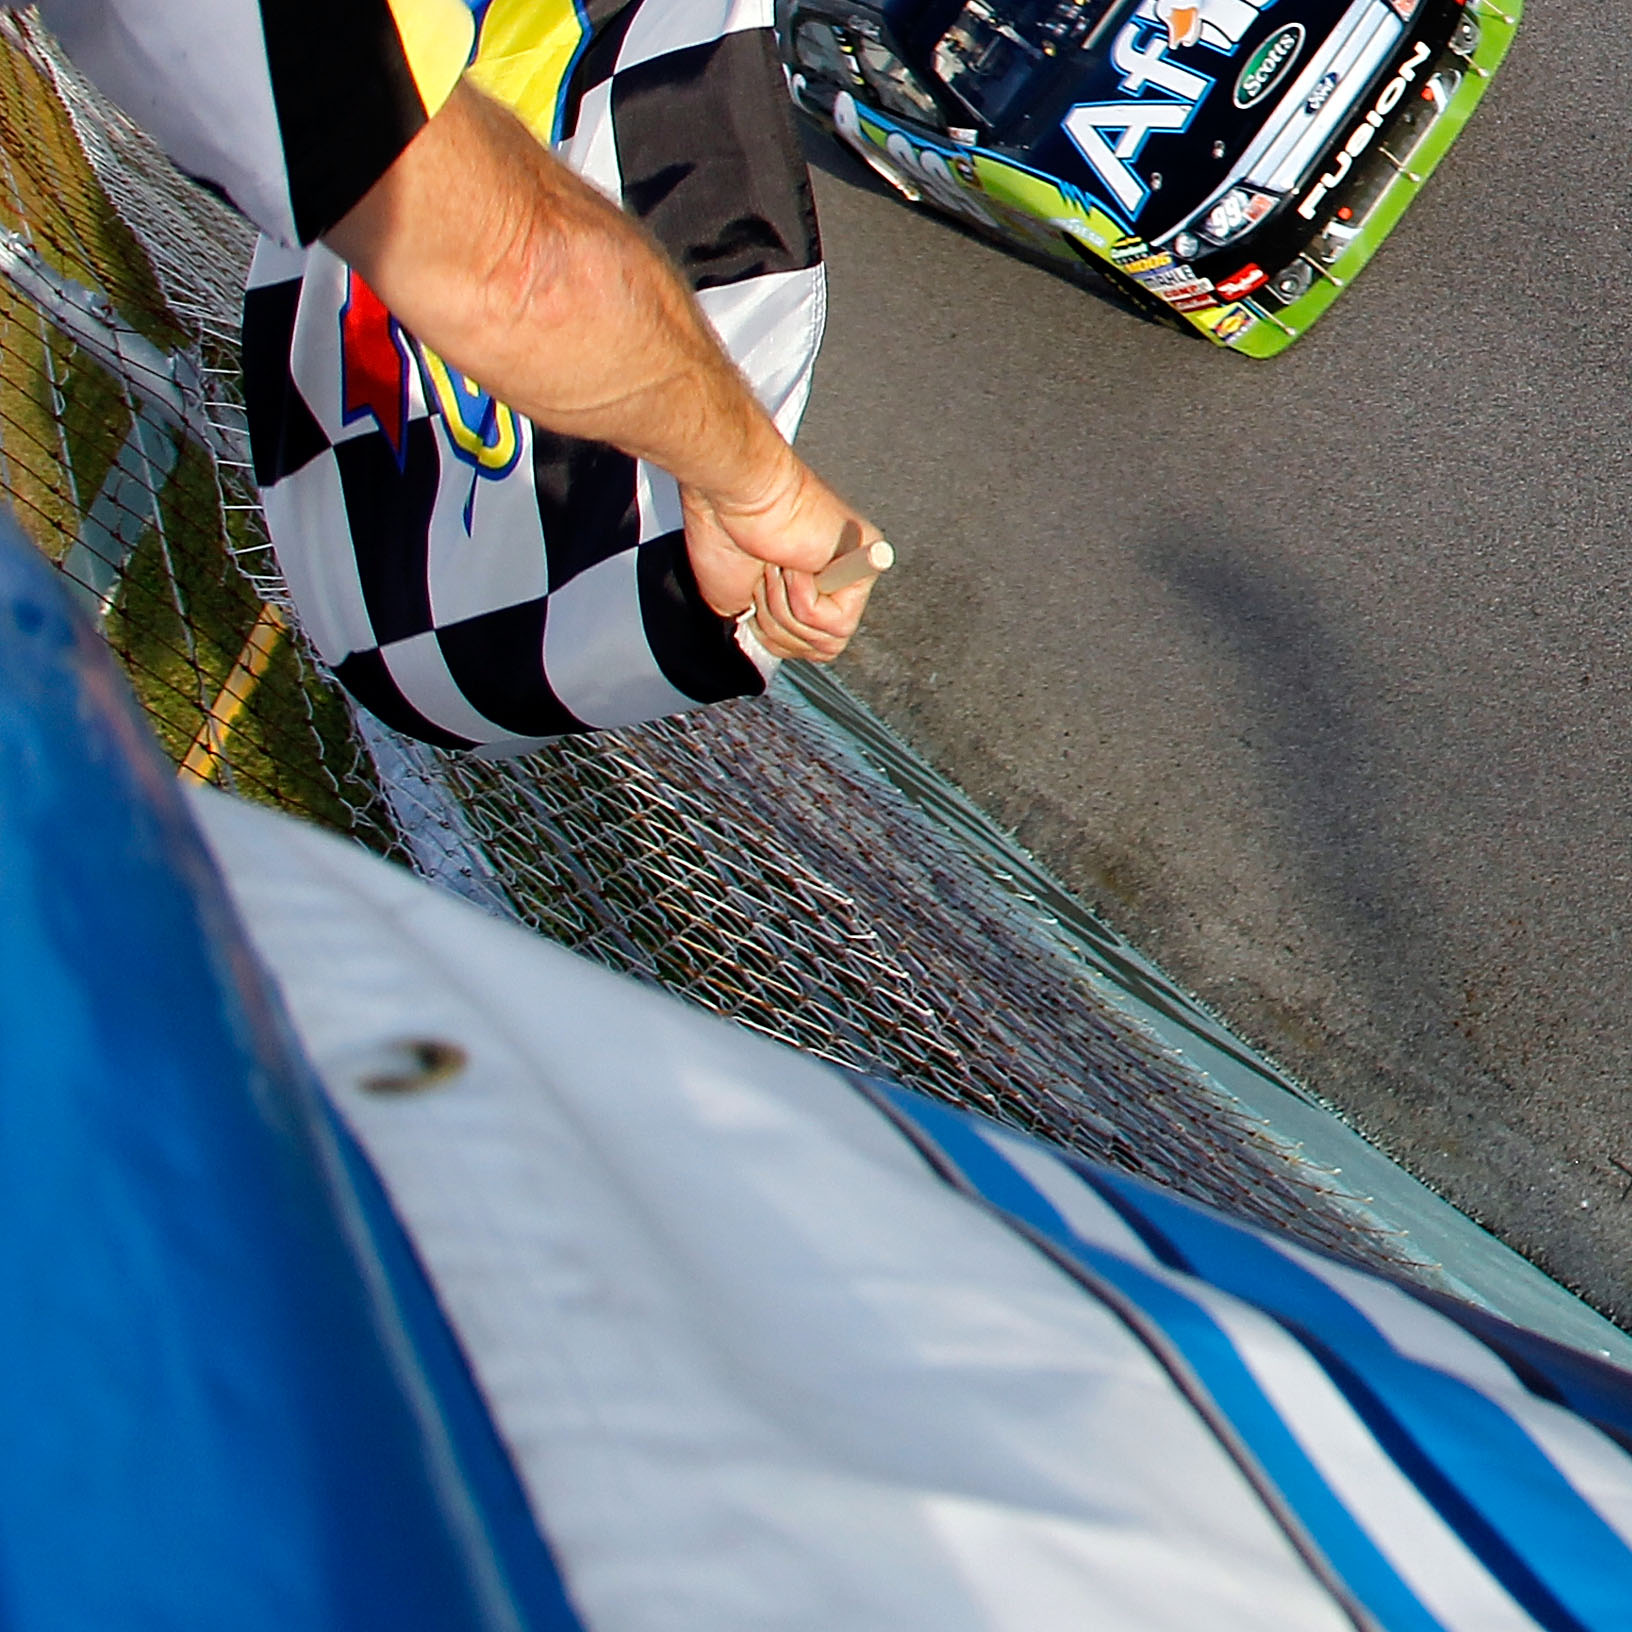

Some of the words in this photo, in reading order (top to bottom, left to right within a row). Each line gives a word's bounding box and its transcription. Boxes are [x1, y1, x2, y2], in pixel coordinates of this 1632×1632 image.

[1242, 33, 1297, 98] Scotts
[1297, 41, 1431, 220] FUSION
[1207, 189, 1249, 237] 99
